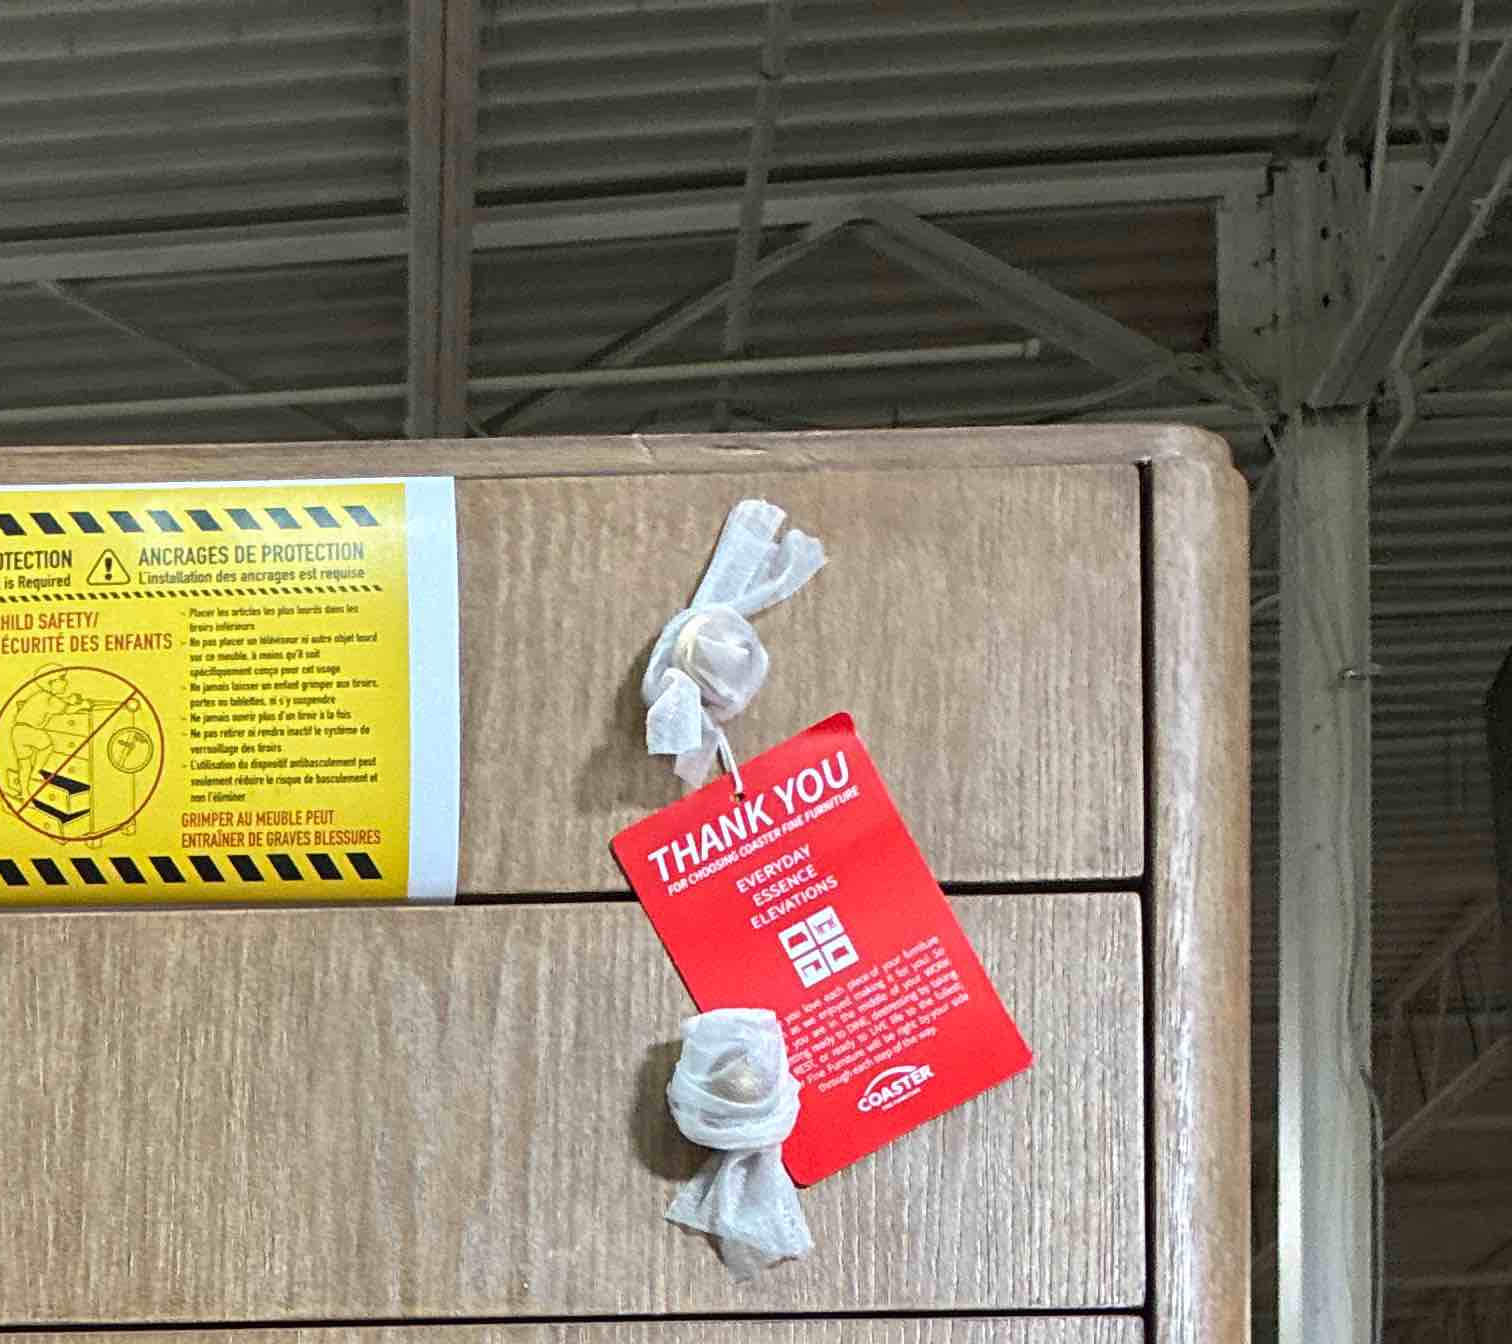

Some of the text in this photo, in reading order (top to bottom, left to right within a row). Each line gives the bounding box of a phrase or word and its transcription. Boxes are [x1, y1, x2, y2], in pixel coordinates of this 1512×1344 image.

[138, 542, 364, 566] ANCRAGES DE PROTECTION
[3, 579, 14, 589] is
[17, 574, 71, 588] Required
[215, 569, 237, 583] des
[240, 570, 295, 582] ancrages
[298, 567, 317, 580] est
[319, 568, 365, 580] requise
[38, 611, 99, 629] SAFETY/
[69, 634, 99, 652] DES
[104, 632, 172, 651] ENFANTS
[181, 809, 335, 827] GRIMPER AU MEUBLE PEUT
[646, 749, 849, 882] THANK YOU
[247, 831, 262, 847] DE
[266, 830, 311, 846] GRAVES
[313, 829, 381, 845] BLESSURES
[666, 784, 859, 896] FOR CHOOSING COASTER FINE FURNITURE
[734, 843, 810, 893] EVERYDAY
[751, 863, 818, 907] ESSENCE
[749, 874, 838, 929] ELEVATIONS
[856, 1063, 935, 1112] COASTER
